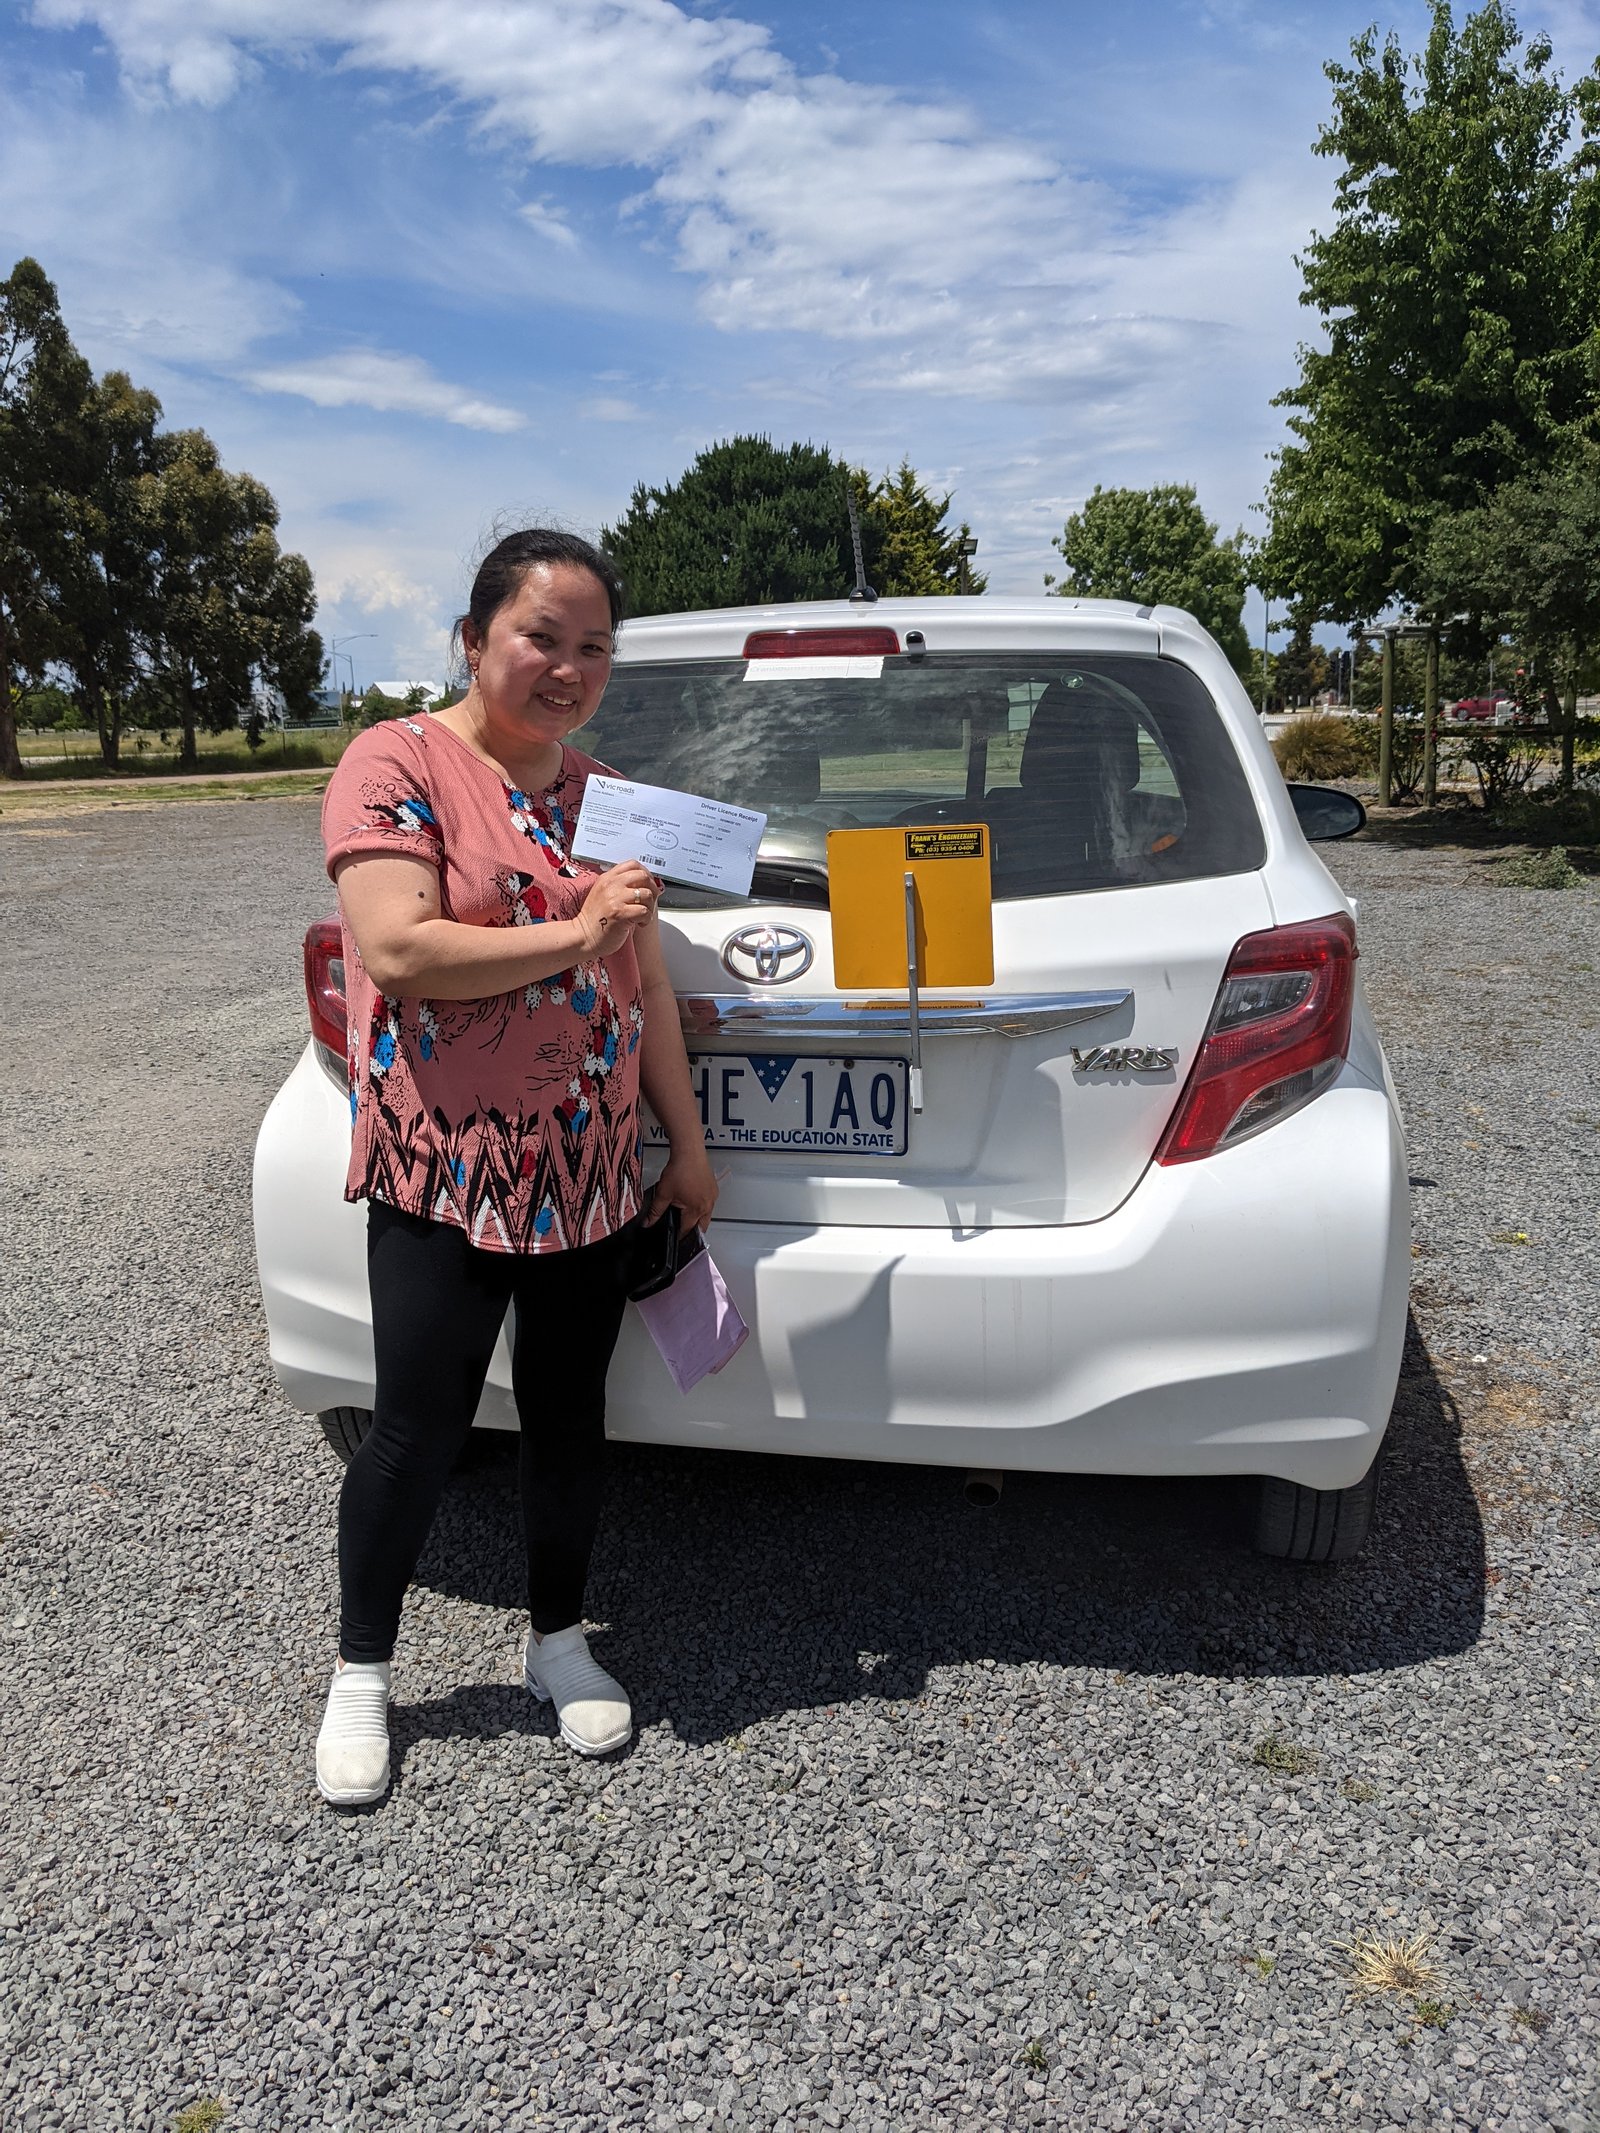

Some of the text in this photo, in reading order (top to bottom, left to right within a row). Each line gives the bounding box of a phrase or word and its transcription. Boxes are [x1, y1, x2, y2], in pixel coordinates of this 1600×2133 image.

[701, 803, 717, 811] Driver
[718, 807, 738, 817] Licence
[738, 812, 758, 822] Receipt
[938, 832, 978, 841] ENGINEERING
[690, 1067, 896, 1131] HE 1AQ
[730, 1129, 757, 1142] THE
[762, 1130, 847, 1147] EDUCATION
[852, 1133, 894, 1148] STATE
